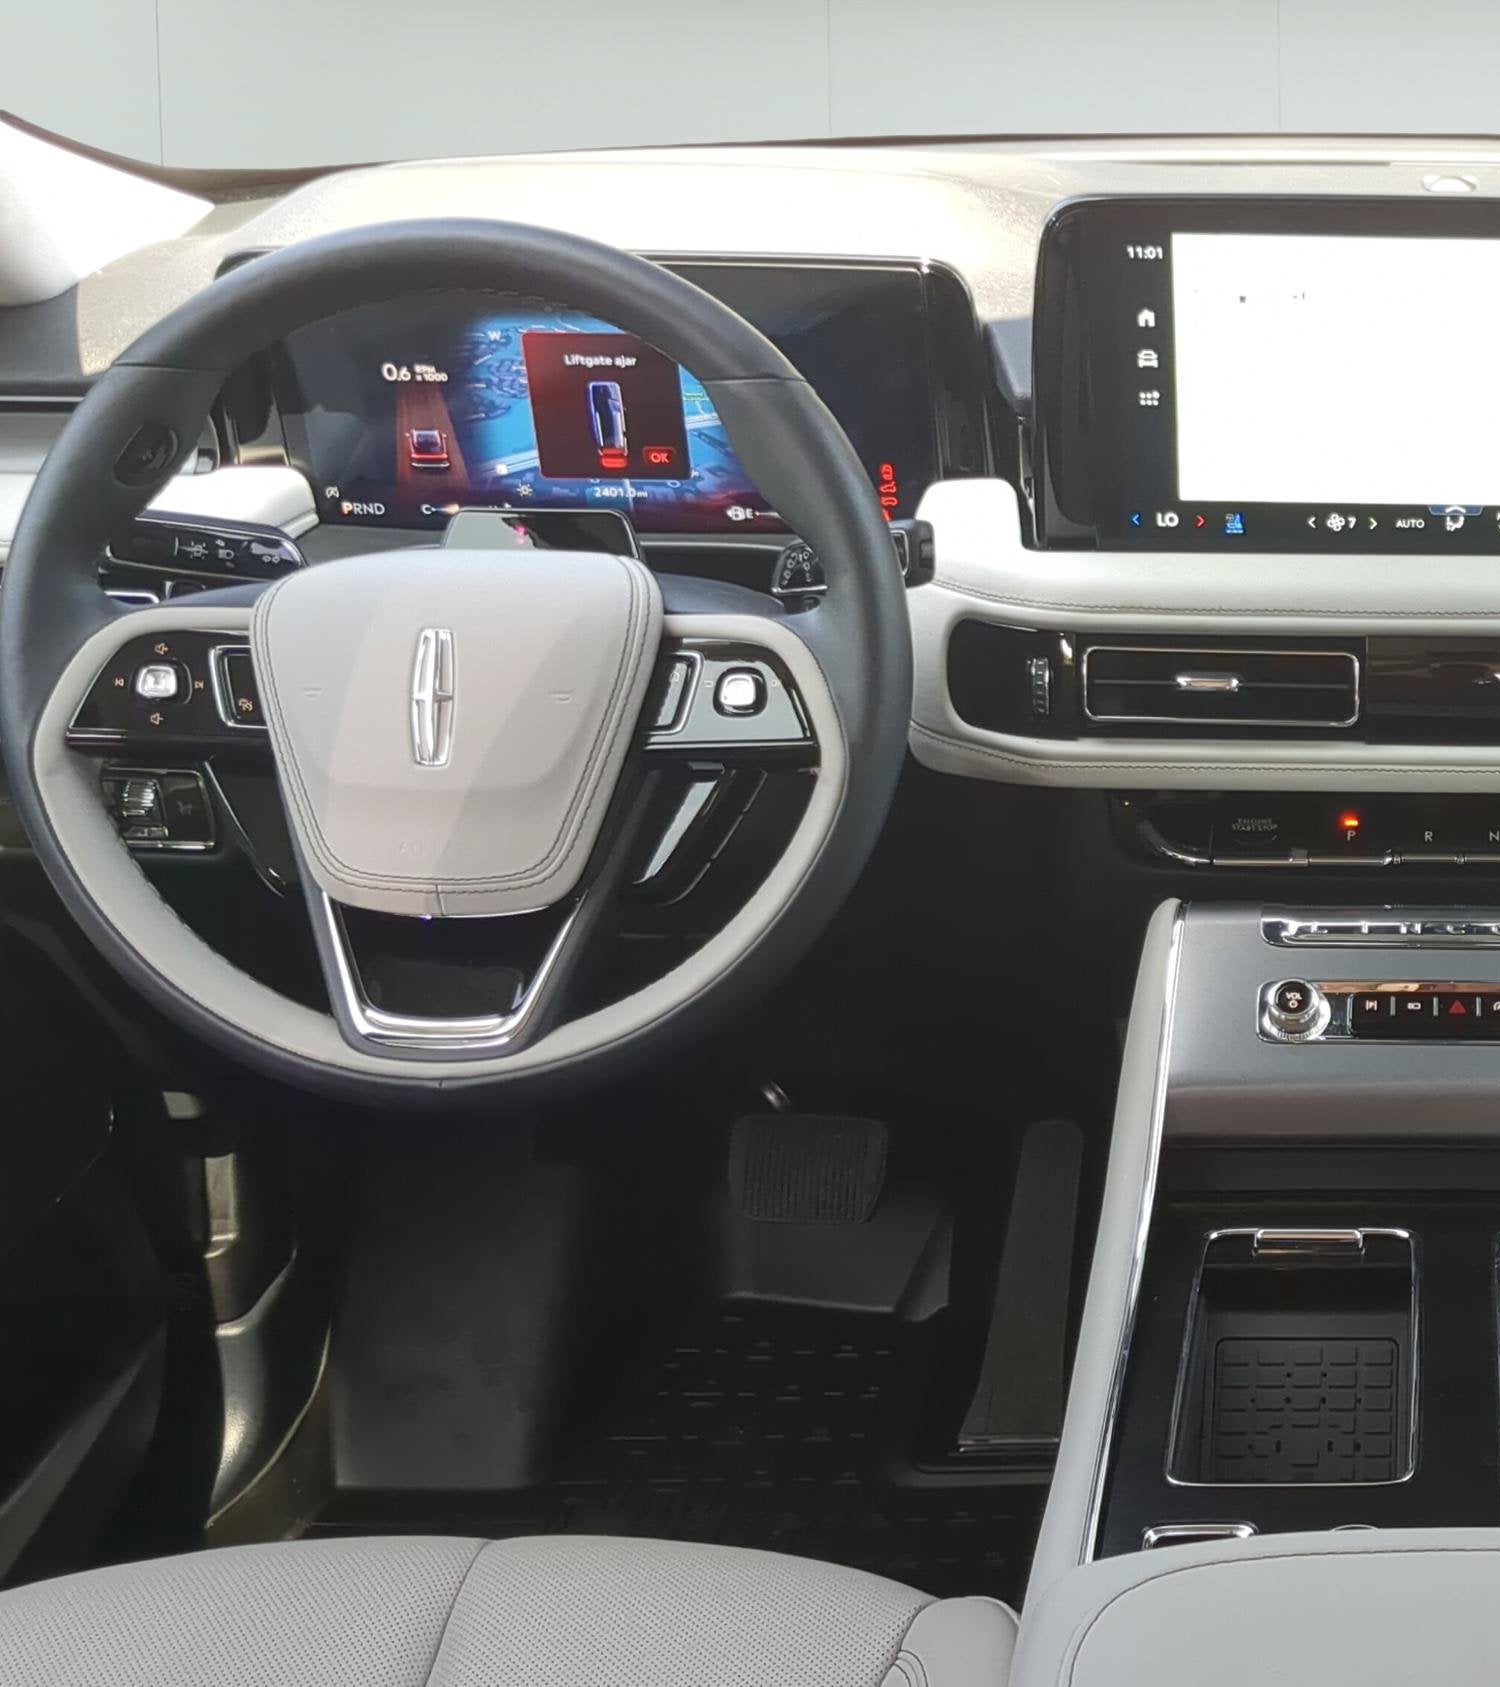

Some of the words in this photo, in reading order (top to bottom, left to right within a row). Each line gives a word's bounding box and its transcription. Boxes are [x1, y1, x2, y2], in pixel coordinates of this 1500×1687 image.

[1126, 245, 1163, 259] 11:01
[564, 353, 613, 368] Liftgate
[615, 354, 637, 369] ajar
[381, 362, 411, 381] 0.6
[423, 372, 448, 382] 1000
[650, 452, 670, 464] OK
[1155, 512, 1179, 527] LO
[1347, 517, 1356, 528] 7
[1396, 518, 1425, 529] AUTO
[1347, 829, 1356, 841] P
[1424, 830, 1434, 842] R
[1488, 830, 1500, 842] N
[1285, 992, 1302, 1001] VOL
